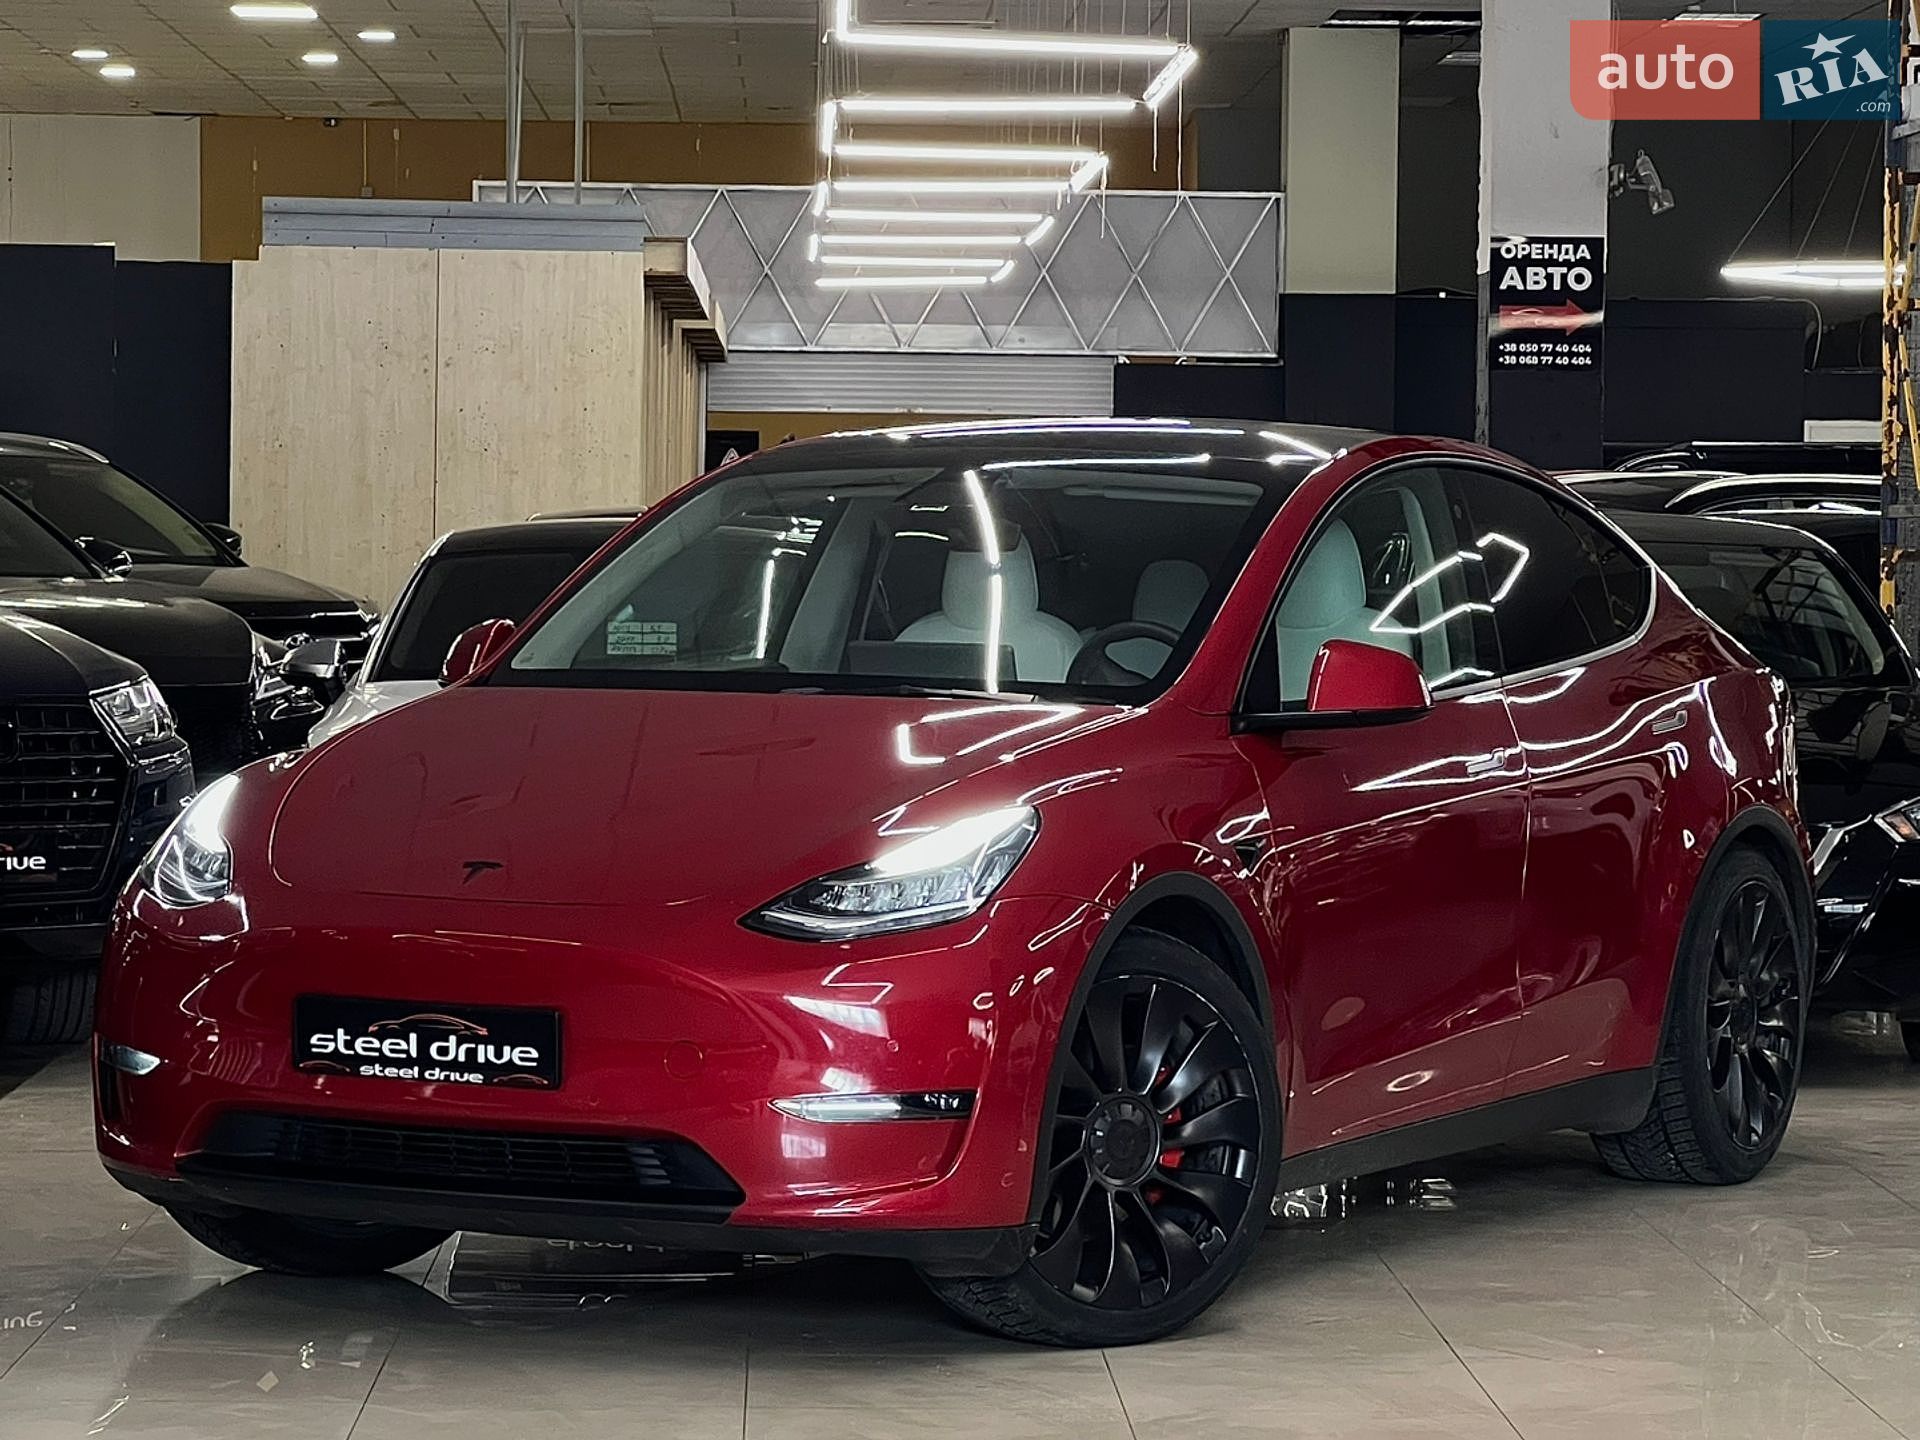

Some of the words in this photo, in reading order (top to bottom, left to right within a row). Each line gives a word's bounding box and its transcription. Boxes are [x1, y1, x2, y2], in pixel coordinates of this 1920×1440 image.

[1500, 242, 1592, 262] ОРЕНДА
[1499, 266, 1593, 291] АВТО
[1540, 343, 1553, 353] 77
[1555, 343, 1569, 353] 40
[1571, 343, 1592, 353] 404
[1540, 355, 1553, 365] 77
[1555, 355, 1569, 365] 40
[1571, 355, 1592, 365] 404
[309, 1027, 418, 1059] steel
[429, 1034, 540, 1067] drive
[359, 1062, 419, 1079] steel
[424, 1066, 485, 1084] drive
